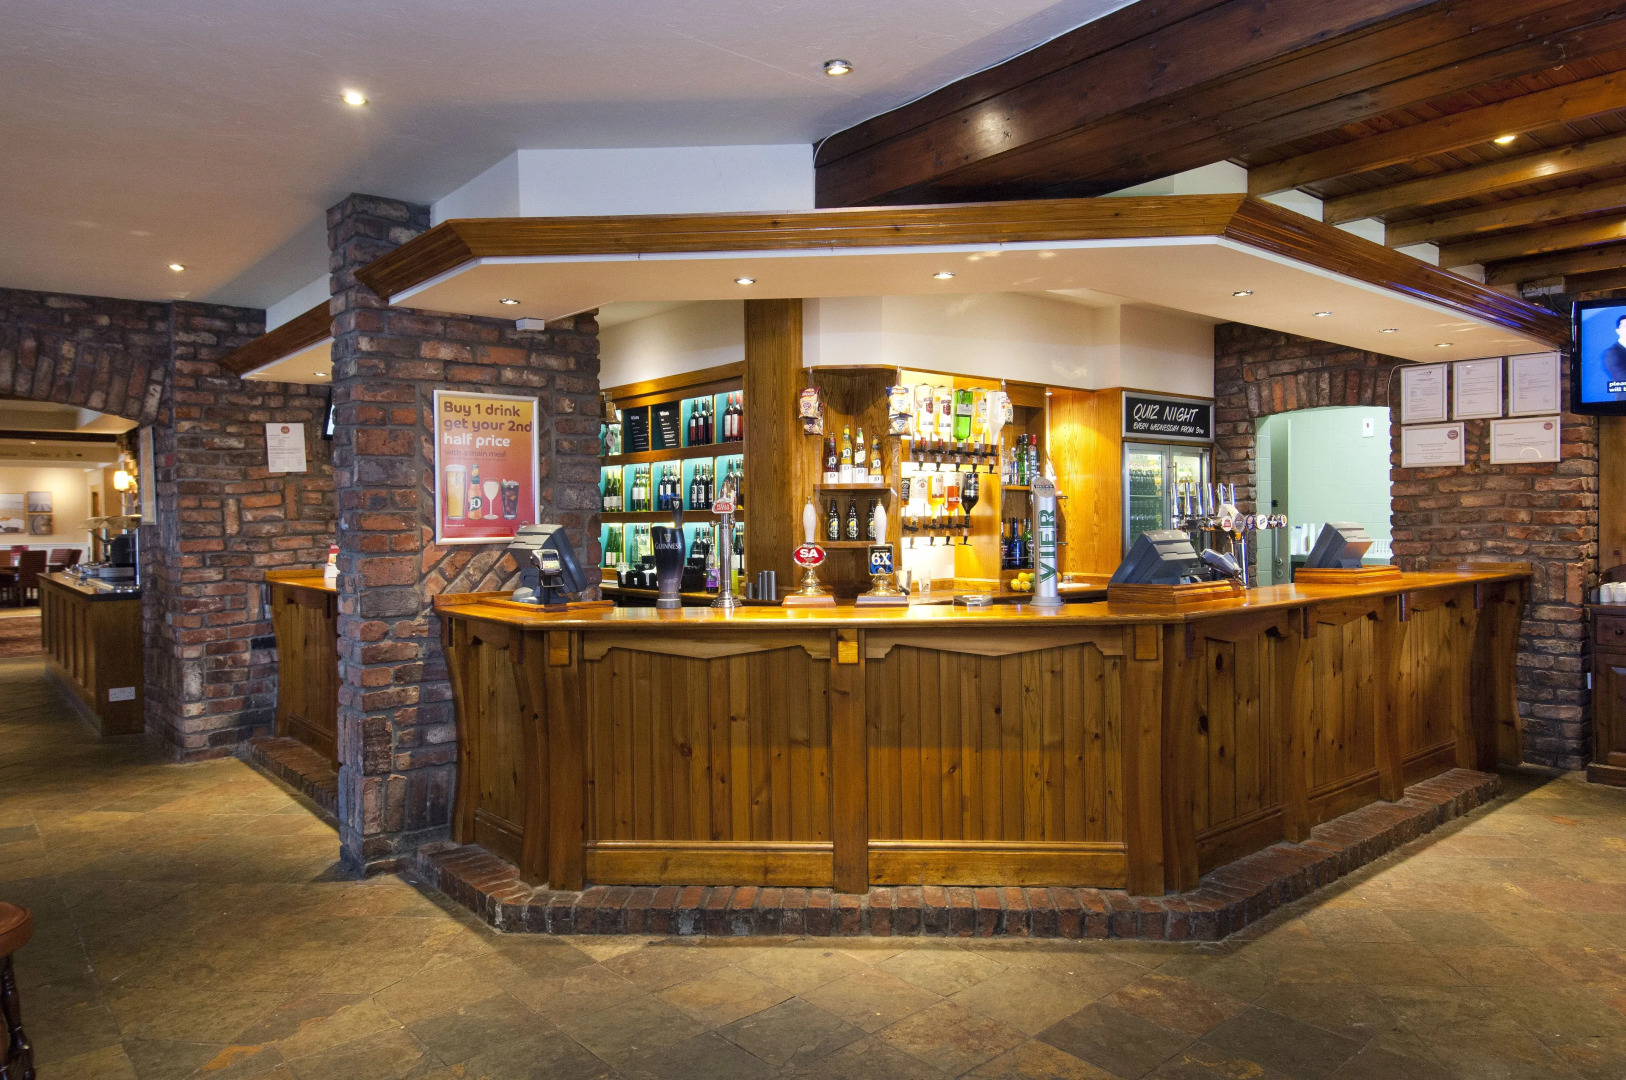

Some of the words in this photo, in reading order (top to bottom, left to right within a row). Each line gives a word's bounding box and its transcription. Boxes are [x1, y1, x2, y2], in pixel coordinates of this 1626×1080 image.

[444, 401, 471, 416] Buy
[475, 403, 481, 414] 1
[485, 404, 520, 417] drink
[1133, 403, 1159, 421] QUIZ
[1163, 406, 1199, 422] NIGHT
[443, 418, 468, 431] get
[472, 421, 505, 432] your
[508, 420, 532, 432] 2nd
[1133, 422, 1149, 430] EVERY
[1150, 423, 1179, 432] WEDNESDAY
[1180, 425, 1194, 433] FROM
[443, 432, 472, 445] half
[475, 434, 511, 448] price
[655, 542, 682, 550] GUINNESS
[800, 548, 819, 558] SA
[1039, 509, 1056, 584] VIER
[871, 552, 891, 566] 6X
